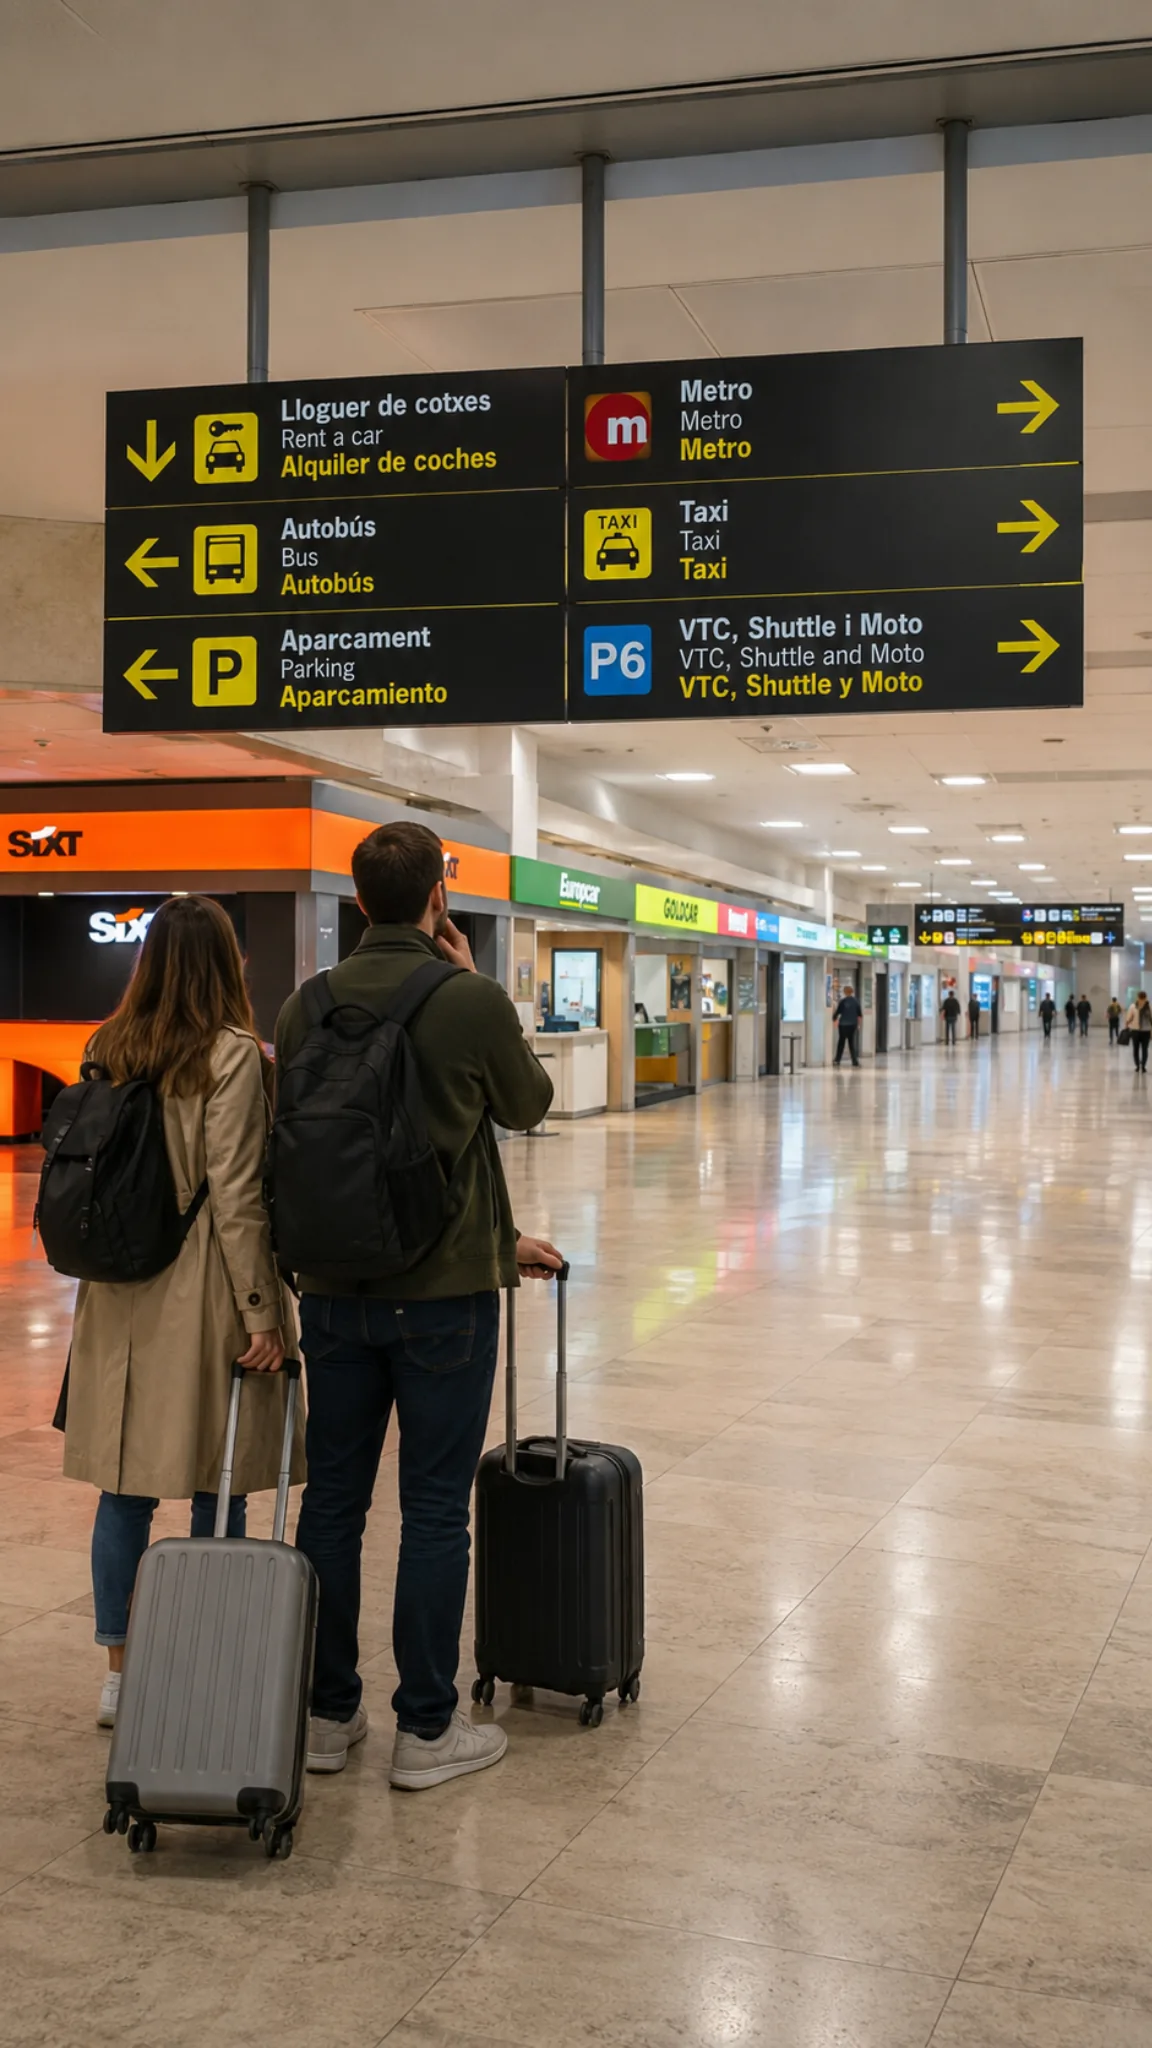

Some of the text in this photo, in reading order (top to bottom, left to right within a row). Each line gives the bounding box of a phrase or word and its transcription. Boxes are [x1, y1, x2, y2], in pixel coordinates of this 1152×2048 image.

[681, 380, 753, 403] Metro
[281, 392, 491, 424] Lloguer de cotxes
[681, 410, 742, 432] Metro
[282, 429, 384, 449] Rent a car
[607, 415, 648, 445] m
[680, 437, 752, 461] Metro
[280, 447, 497, 482] Alquiler de coches
[597, 514, 638, 531] TAXI
[679, 499, 728, 524] Taxi
[280, 515, 376, 540] Autobús
[679, 529, 720, 551] Taxi
[282, 547, 318, 567] Bus
[679, 556, 727, 580] Taxi
[280, 571, 375, 596] Autobús
[280, 626, 431, 656] Aparcament
[679, 612, 923, 645] VTC, Shuttle i Moto
[281, 657, 355, 682] Parking
[590, 640, 646, 681] P6
[679, 642, 925, 672] VTC, Shuttle and Moto
[208, 648, 242, 696] P
[279, 682, 448, 713] Aparcamiento
[679, 670, 923, 702] VTC, Shuttle y Moto
[559, 872, 600, 908] Europcar
[663, 897, 699, 924] GOLDCAR
